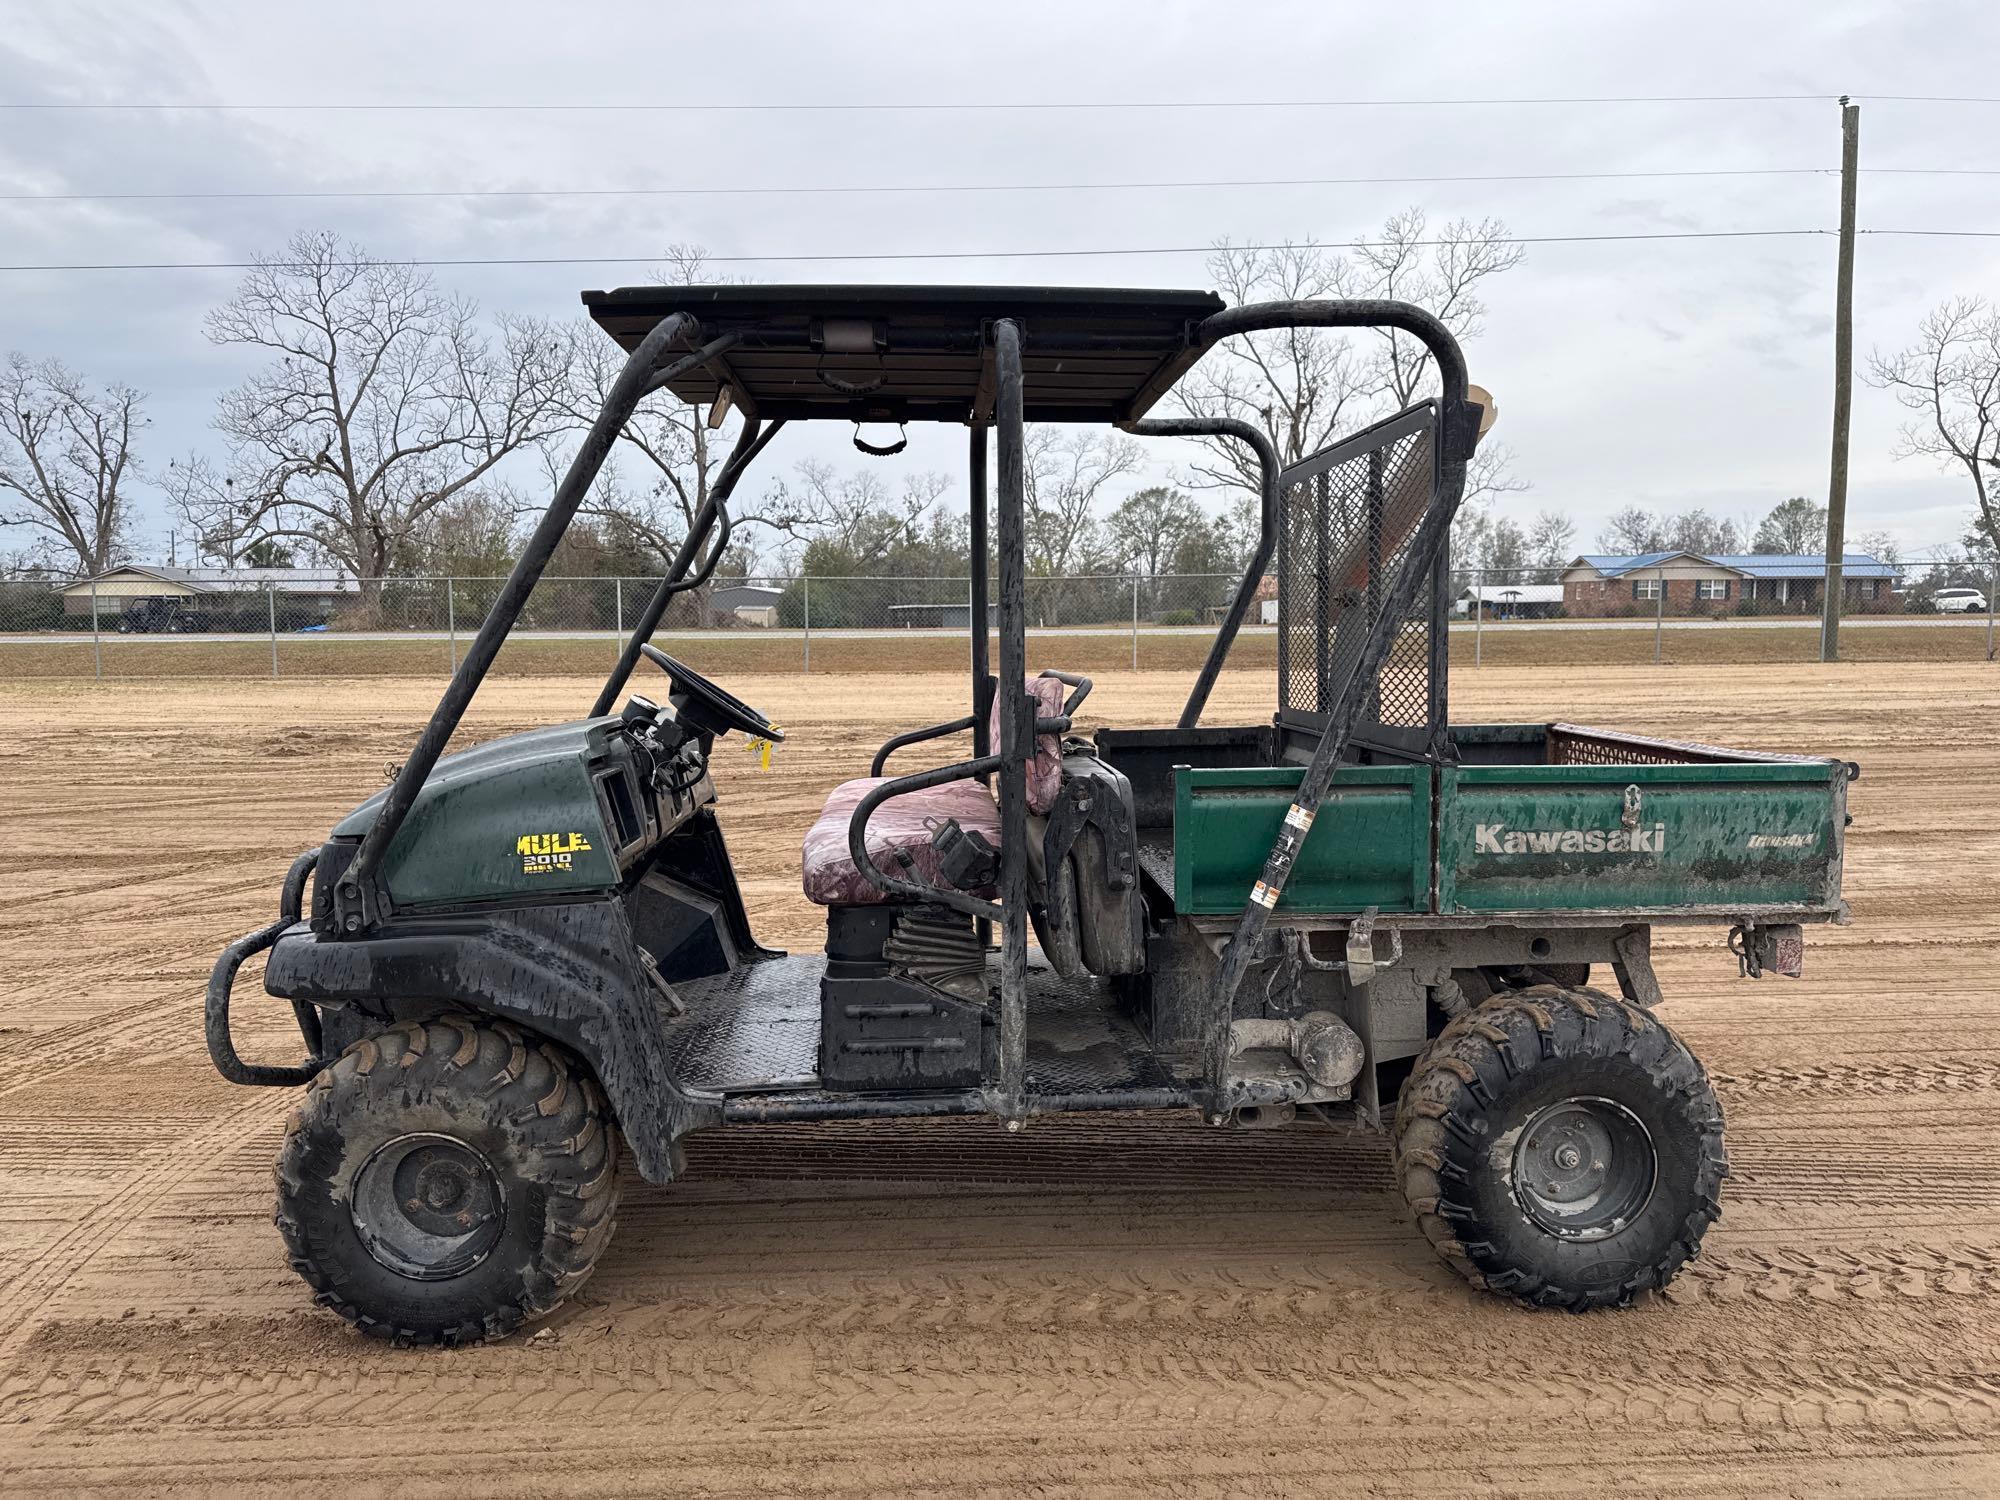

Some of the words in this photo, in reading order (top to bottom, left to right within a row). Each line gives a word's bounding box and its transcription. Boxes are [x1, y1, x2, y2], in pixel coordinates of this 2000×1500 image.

[516, 832, 592, 856] MULE
[1475, 823, 1664, 854] Kawasaki
[523, 853, 572, 866] 3010
